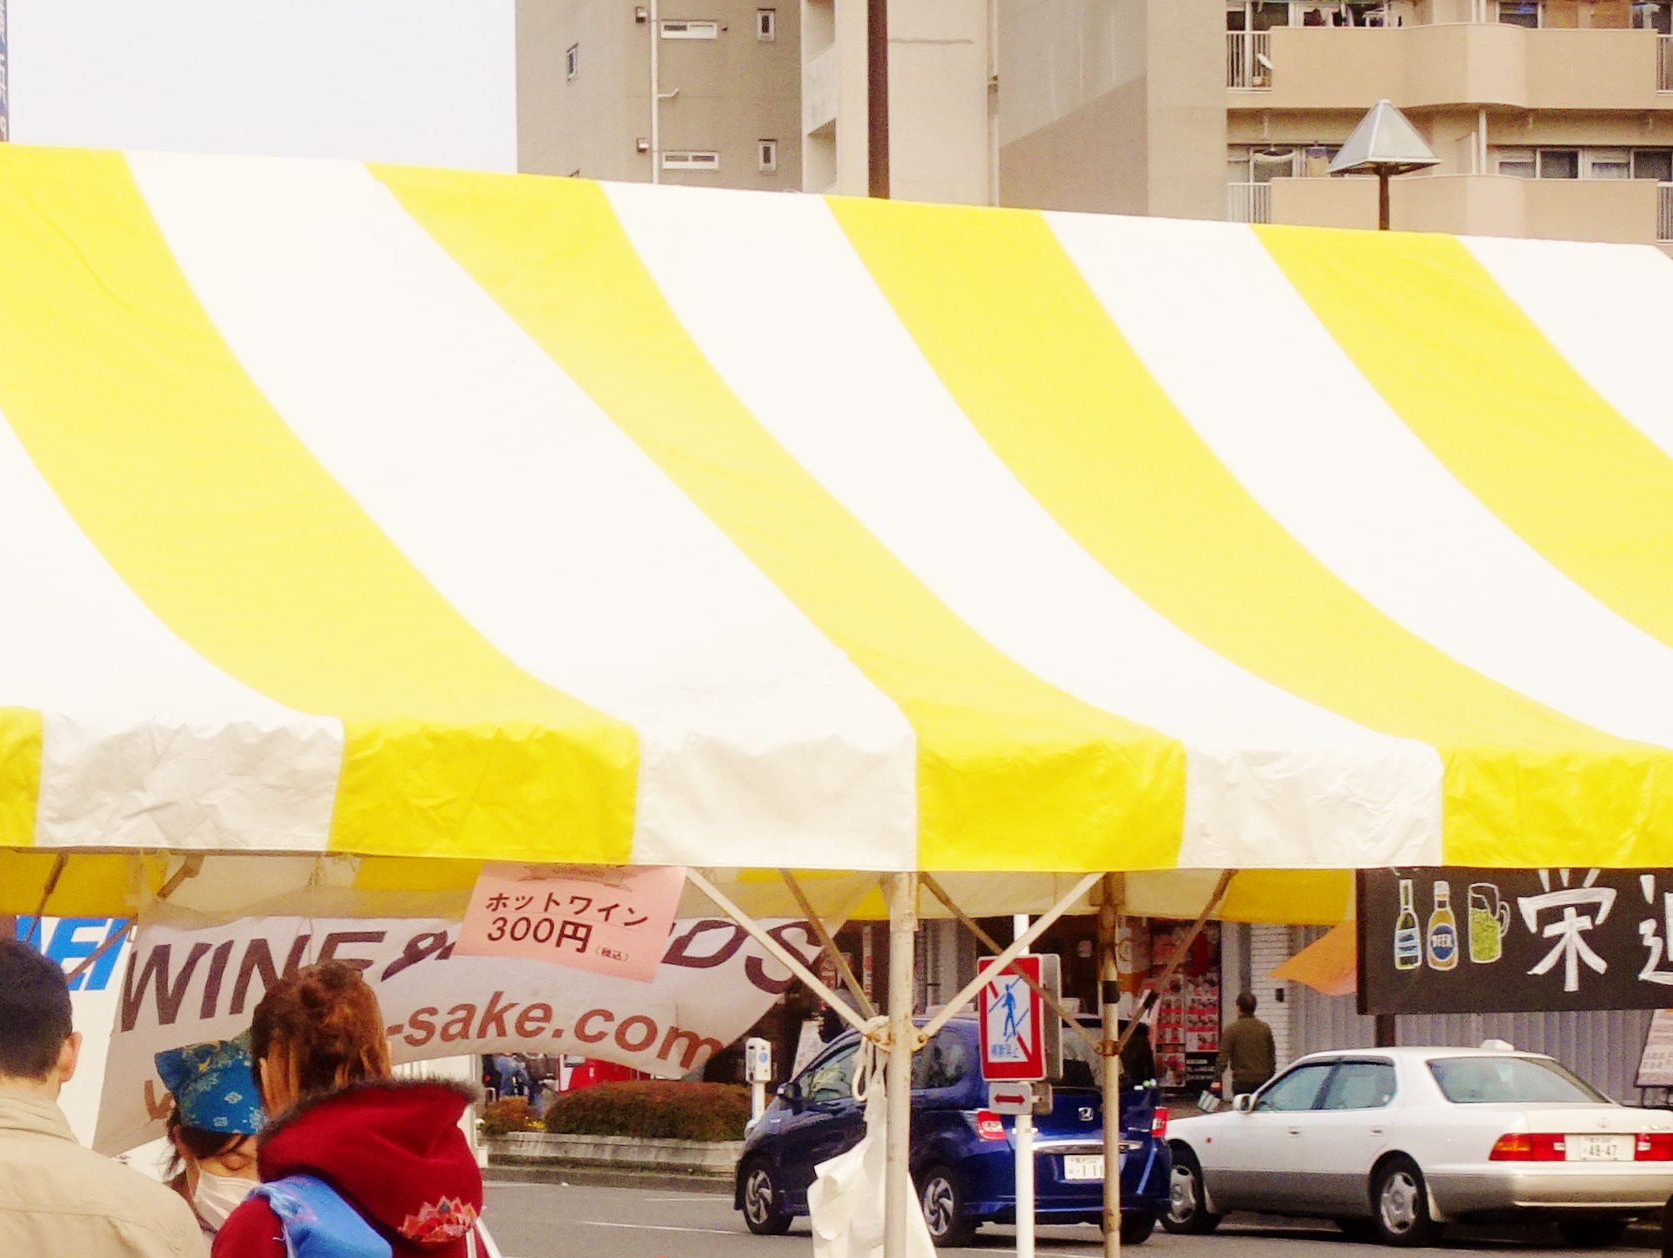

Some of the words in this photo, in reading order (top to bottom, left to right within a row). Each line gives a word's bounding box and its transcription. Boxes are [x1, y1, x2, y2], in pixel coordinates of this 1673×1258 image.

[485, 891, 649, 928] ホットワイン
[486, 916, 594, 954] 300円
